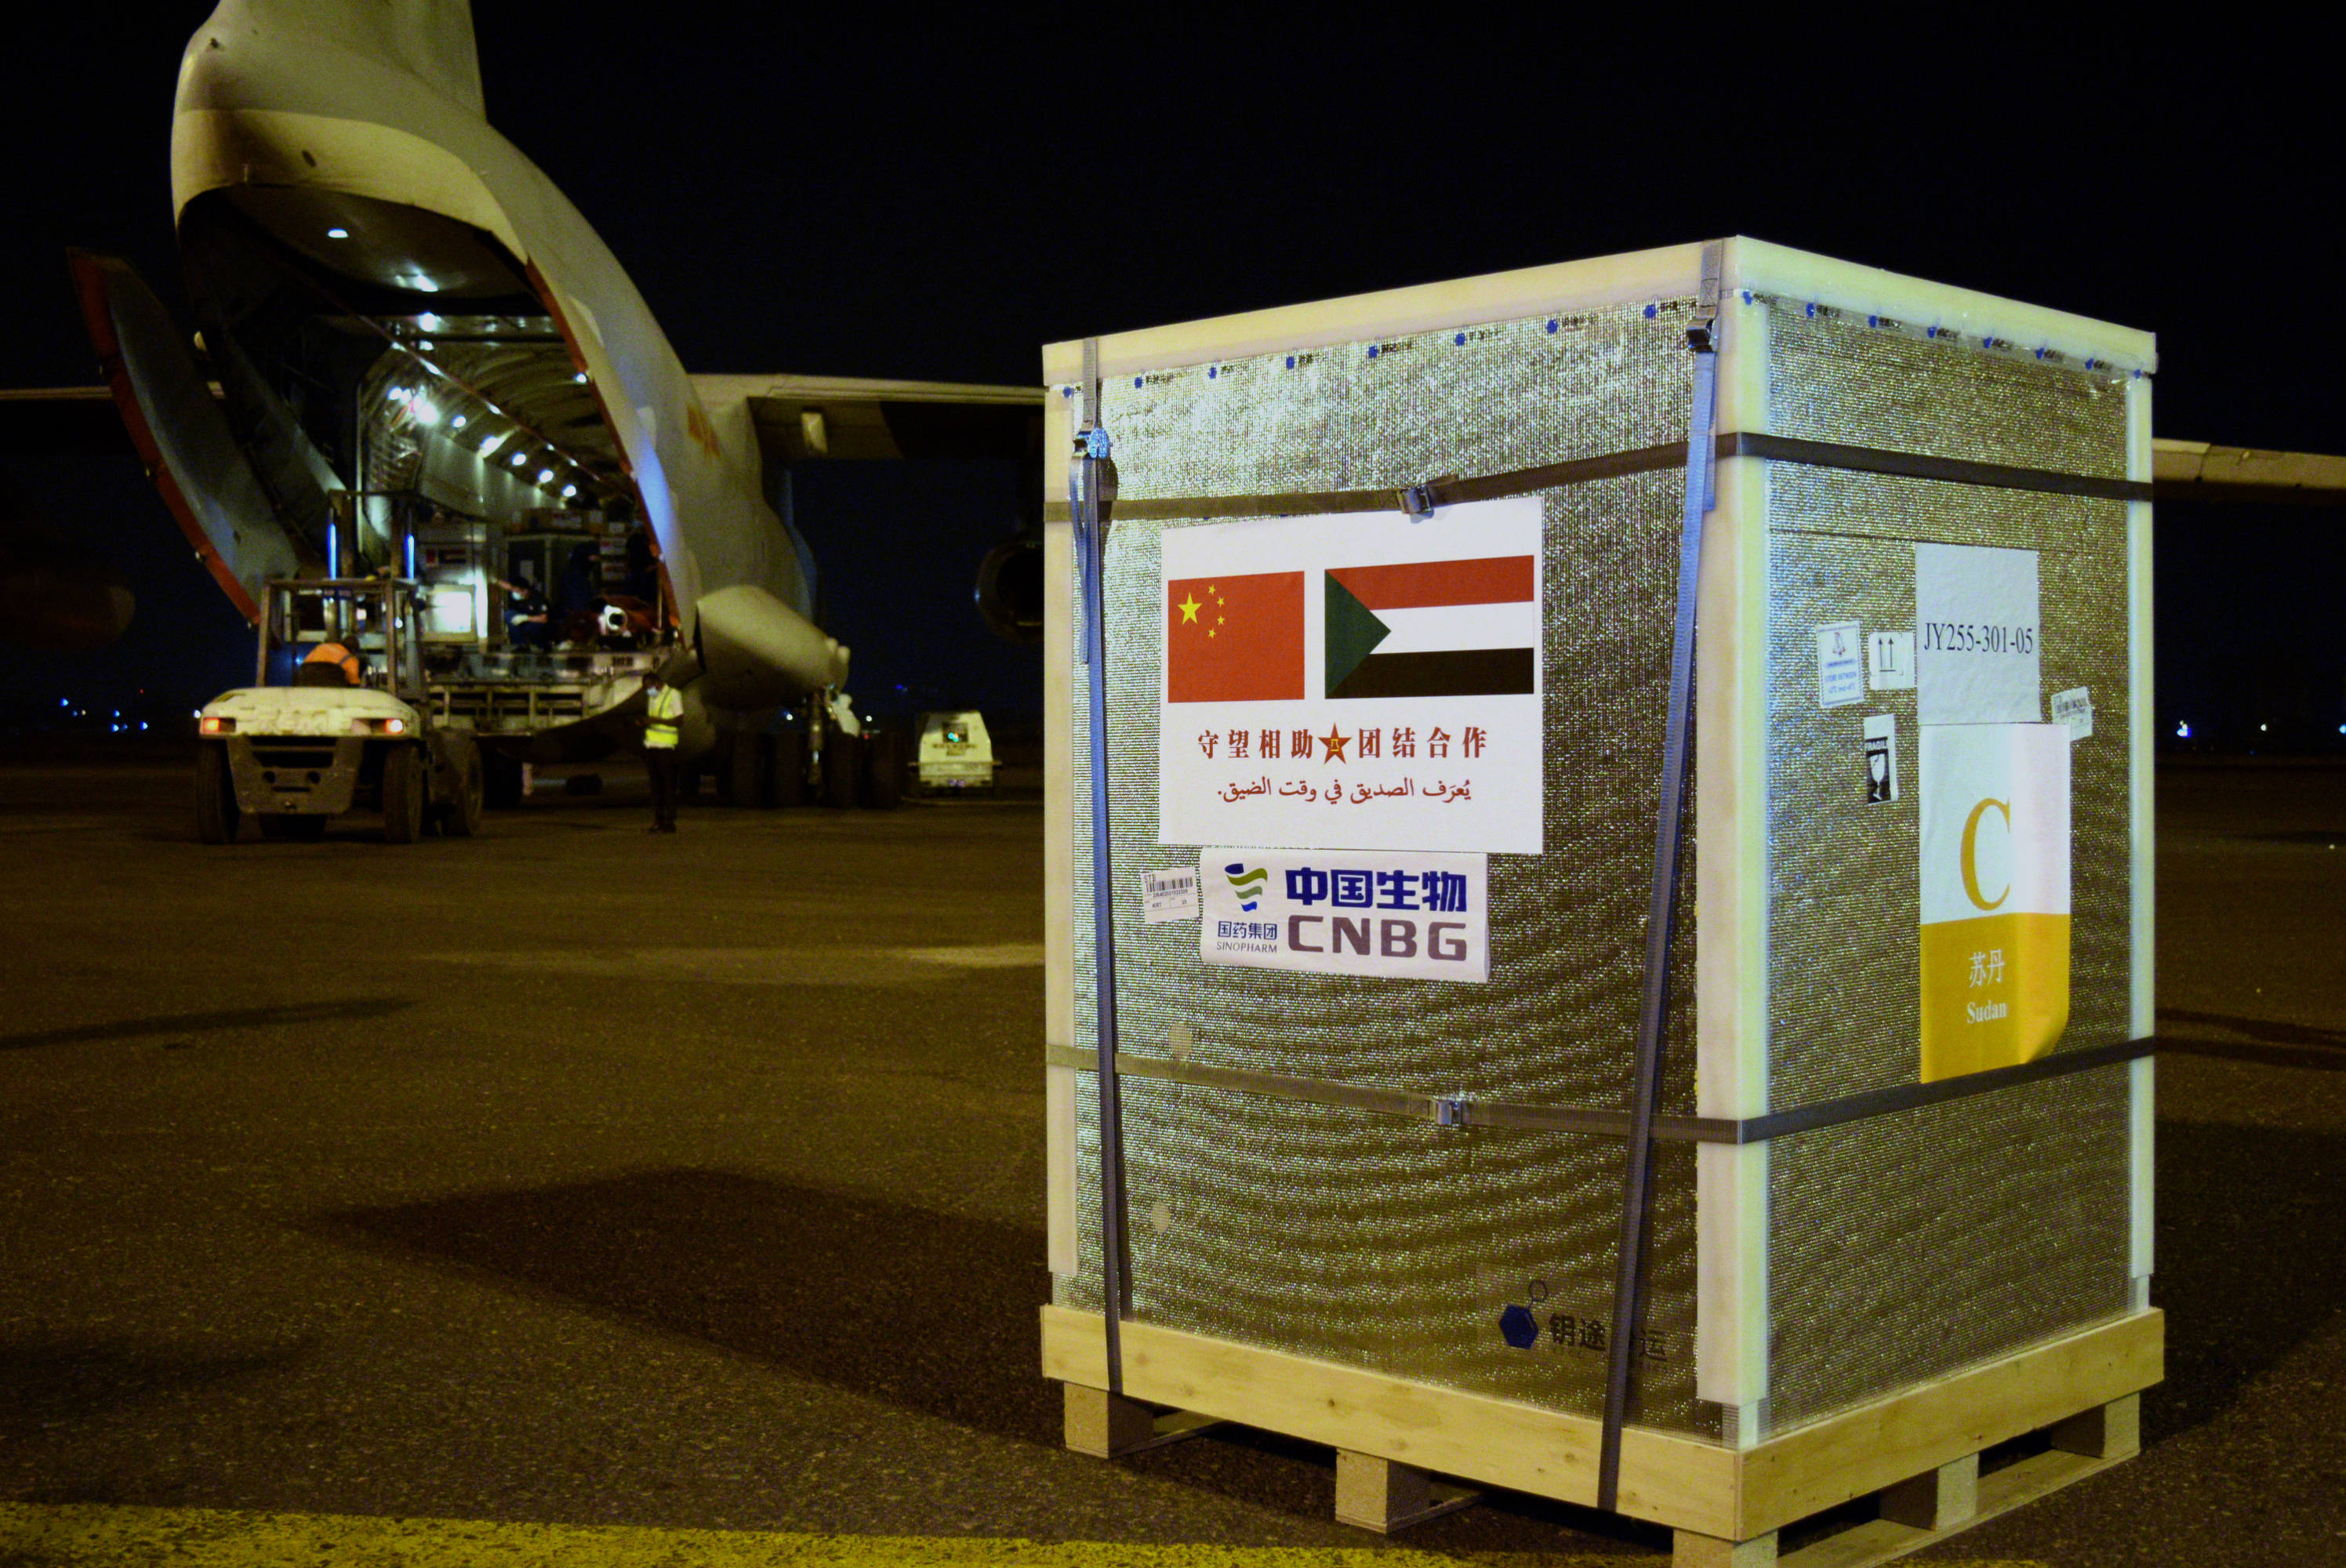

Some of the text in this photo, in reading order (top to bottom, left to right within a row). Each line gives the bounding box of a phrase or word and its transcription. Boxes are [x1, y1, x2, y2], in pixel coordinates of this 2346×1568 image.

[1923, 622, 2033, 654] JY255-301-05
[1197, 726, 1487, 760] 守望相助 团结合作
[1217, 775, 1272, 803] الضيق.
[1278, 780, 1317, 802] وقت
[1324, 779, 1342, 805] في
[1349, 777, 1414, 804] الصديق
[1960, 797, 2010, 911] C
[1285, 866, 1467, 913] 中国生物
[1217, 920, 1278, 940] 国药集团
[1287, 914, 1467, 962] CNBG
[1216, 942, 1277, 953] SINOPHARM
[1969, 949, 2005, 988] 苏丹
[1966, 1000, 2008, 1024] Sudan
